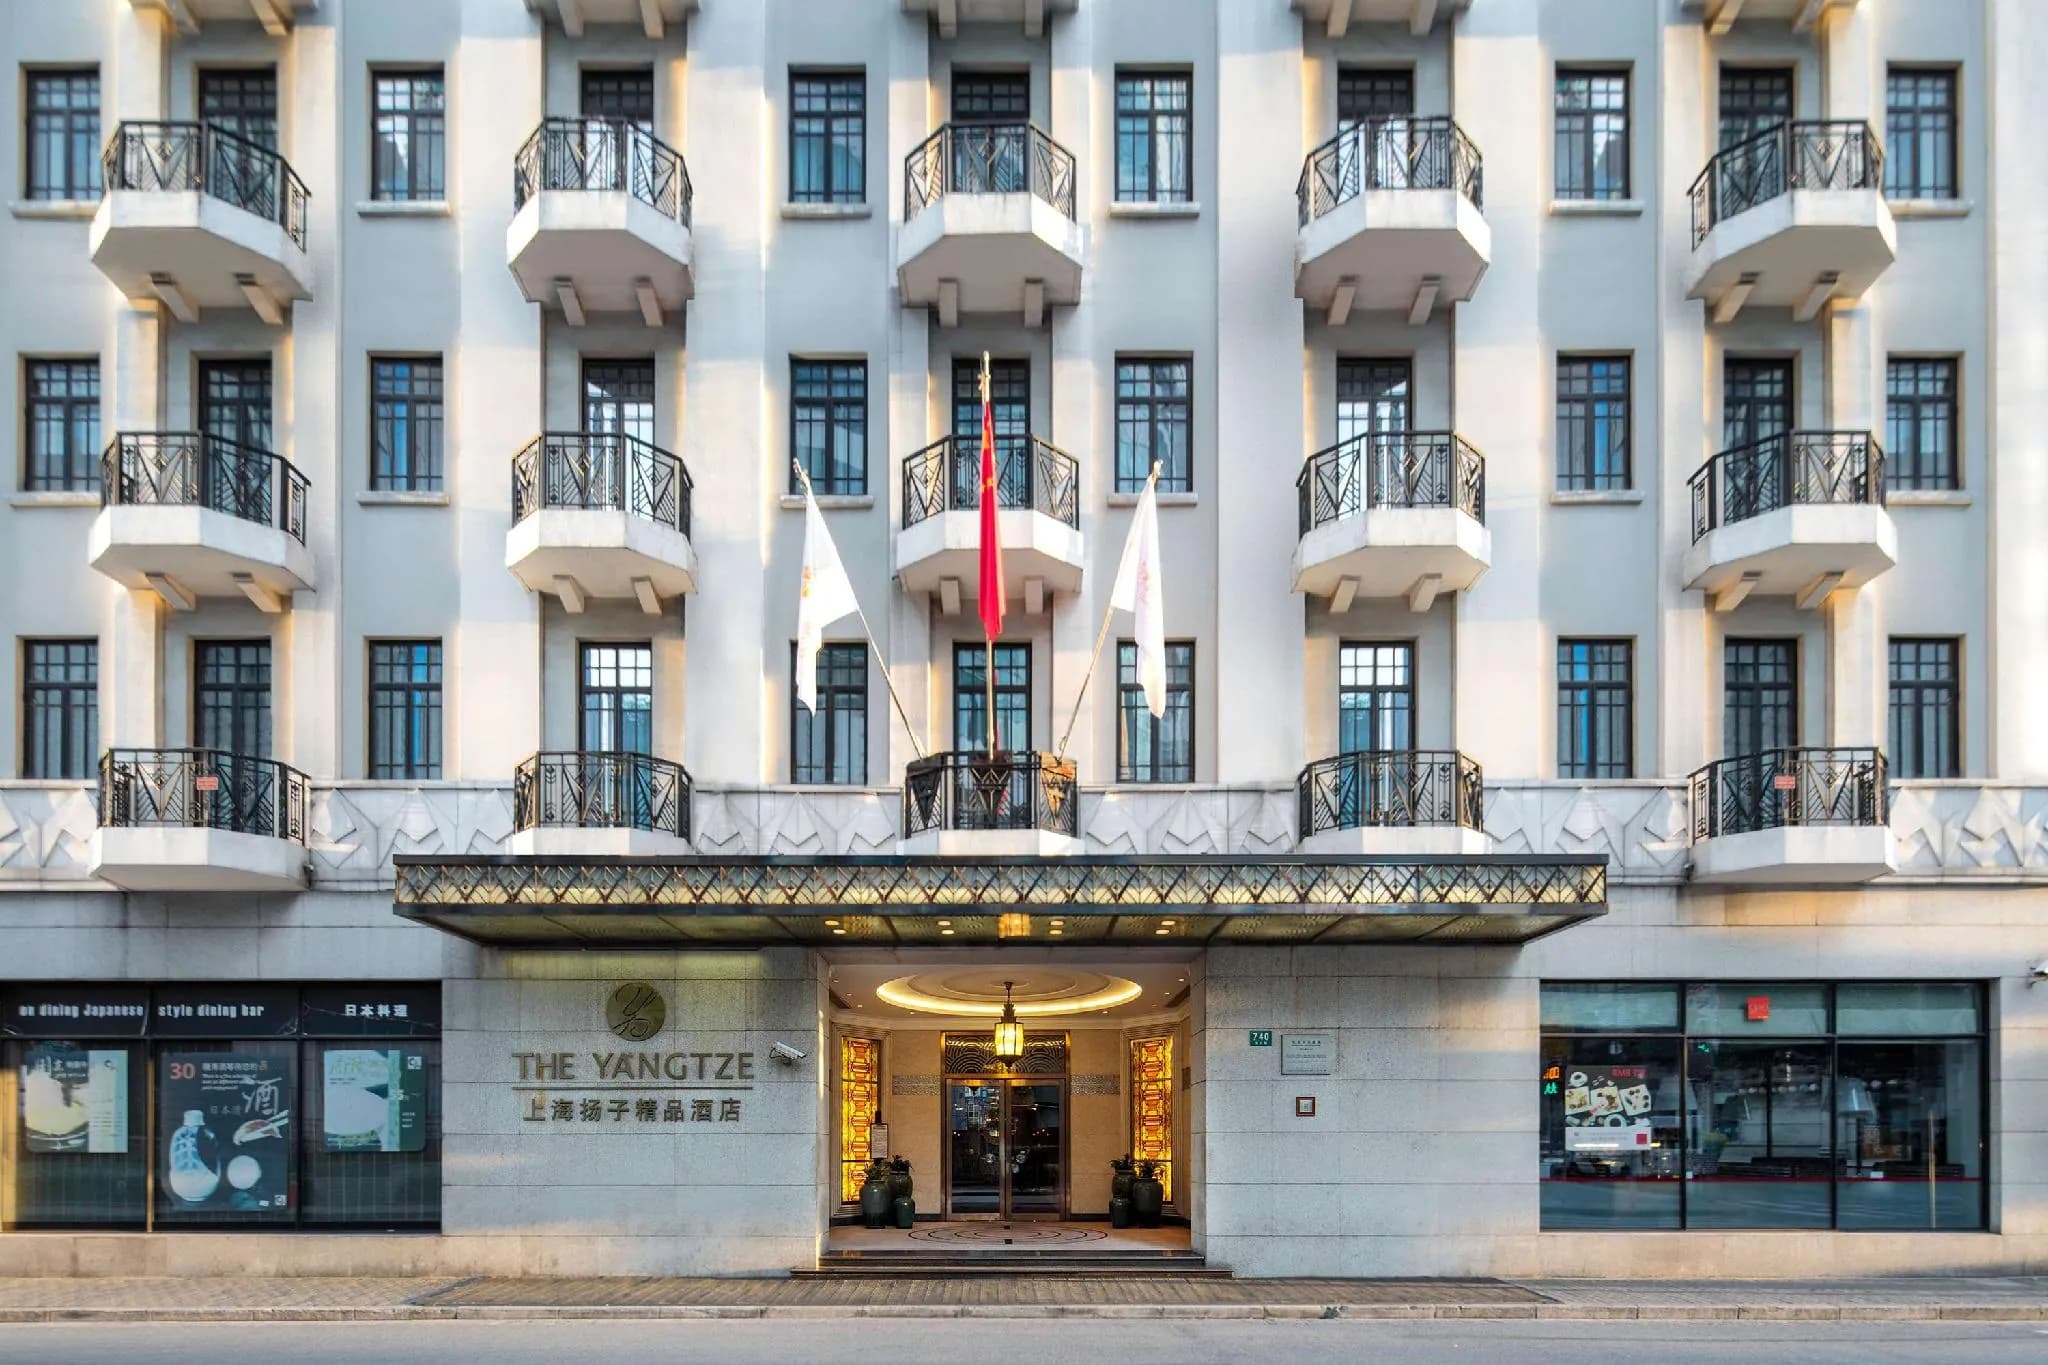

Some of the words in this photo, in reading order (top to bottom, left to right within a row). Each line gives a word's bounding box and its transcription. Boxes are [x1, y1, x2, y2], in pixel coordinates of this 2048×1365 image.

[39, 1003, 79, 1019] dining
[83, 1003, 143, 1018] Japanese
[158, 1004, 193, 1018] style
[197, 1004, 237, 1018] dining
[241, 1004, 265, 1017] bar
[344, 1004, 408, 1017] 日本料理
[1252, 1032, 1269, 1041] 740
[170, 1062, 195, 1080] 30
[511, 1052, 575, 1080] THE
[592, 1052, 754, 1080] YANGTZE
[523, 1098, 742, 1122] 上海扬子精品酒店
